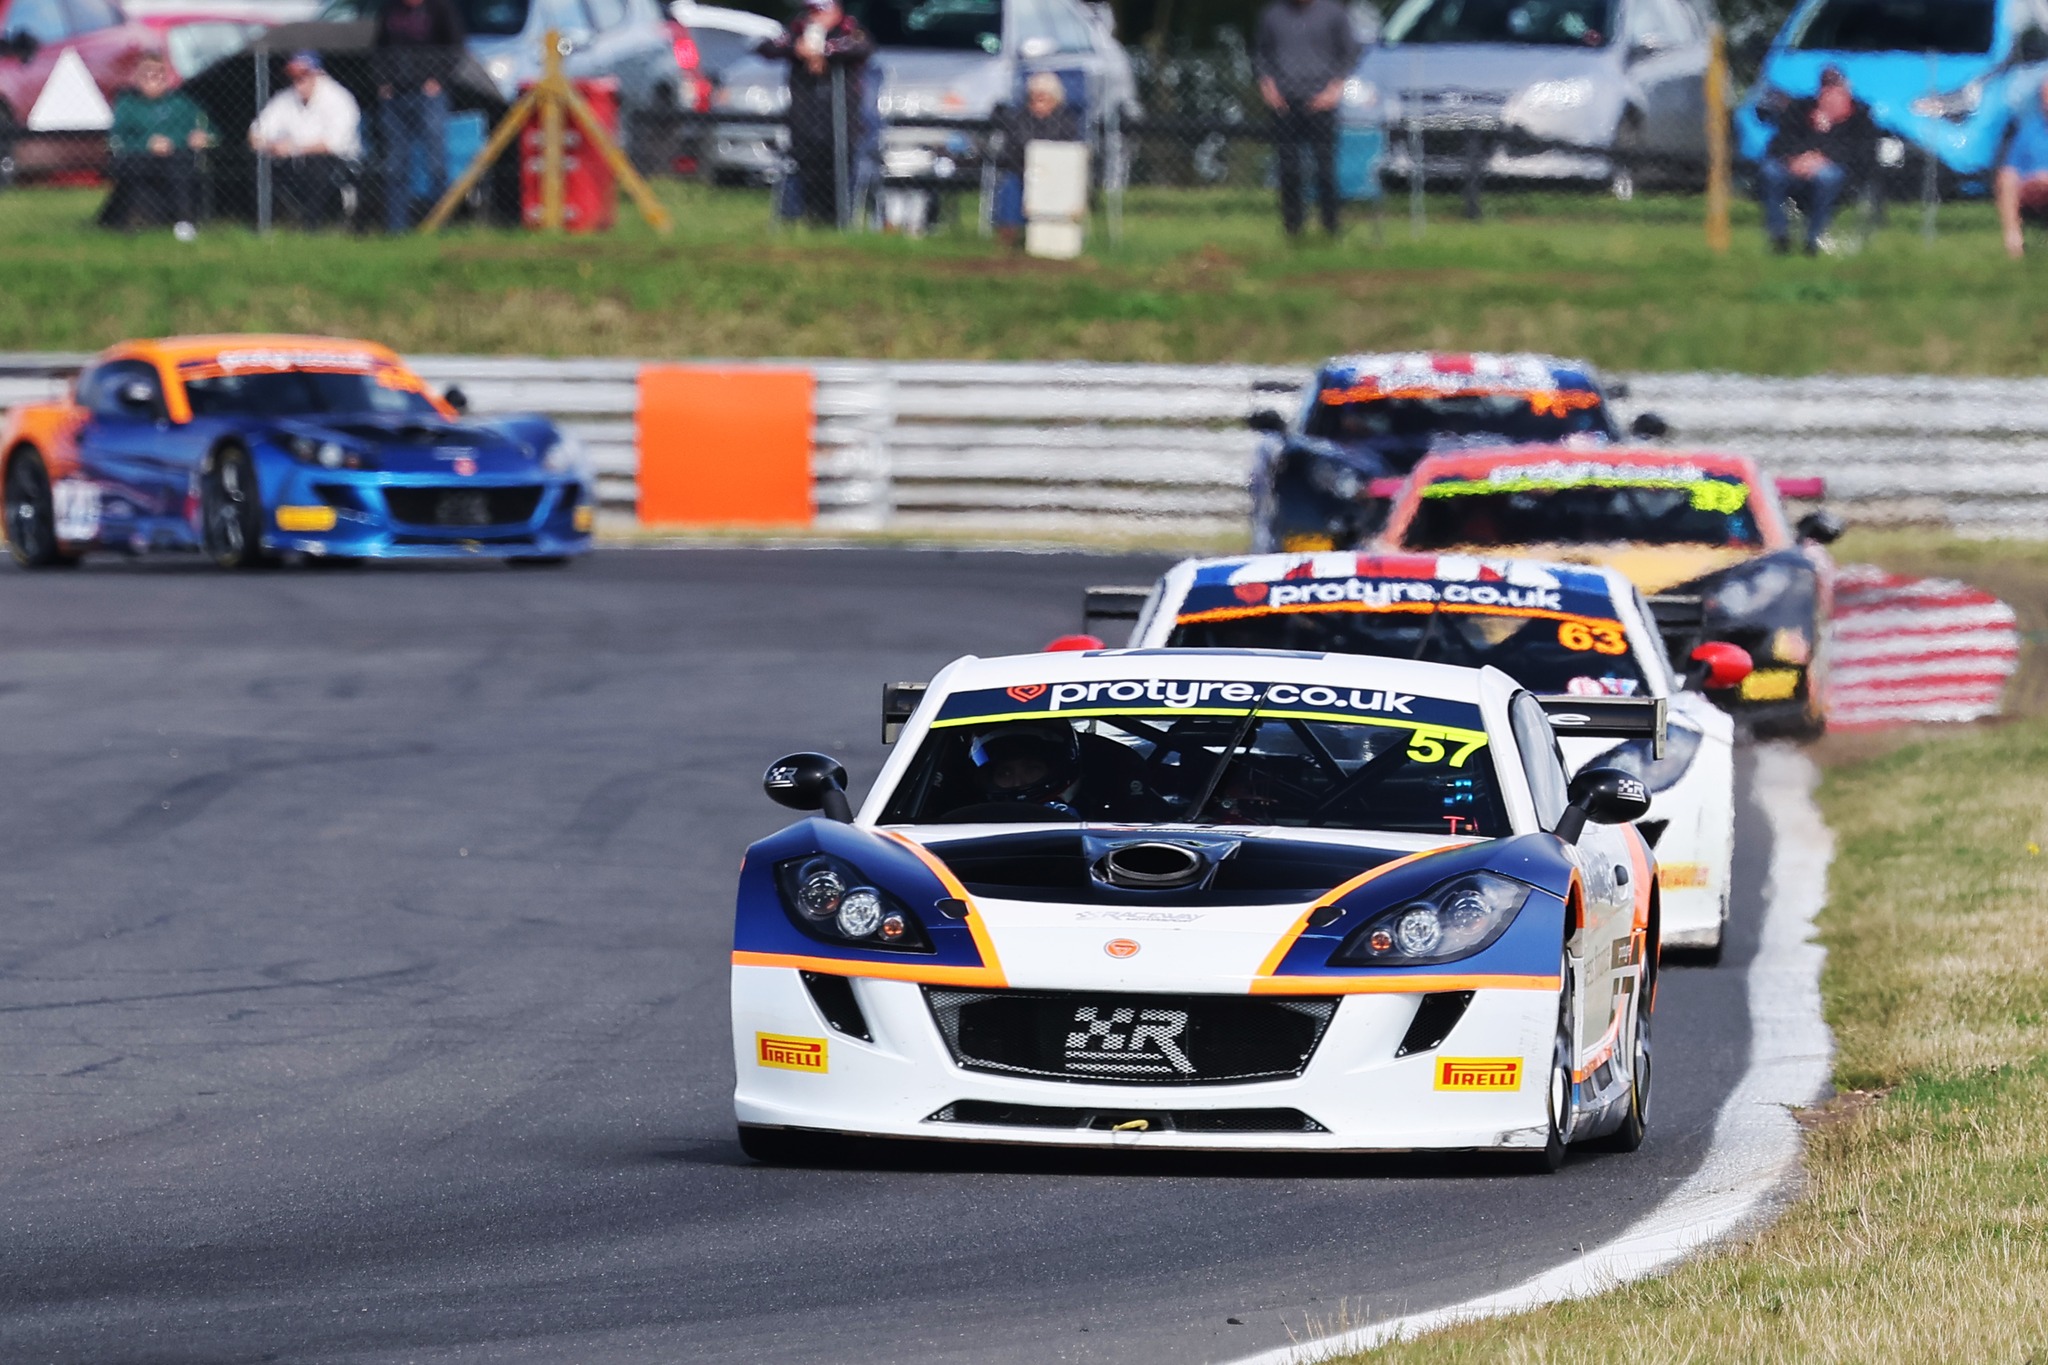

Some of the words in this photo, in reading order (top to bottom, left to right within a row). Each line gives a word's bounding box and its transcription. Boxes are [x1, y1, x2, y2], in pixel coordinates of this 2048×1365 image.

[1269, 577, 1562, 611] protyre.co.uk
[1557, 621, 1628, 656] 63
[1049, 678, 1415, 715] protyre.co.uk
[1406, 728, 1489, 768] 57
[761, 1038, 821, 1067] PIRELLI
[1442, 1062, 1517, 1086] PIRELLI
